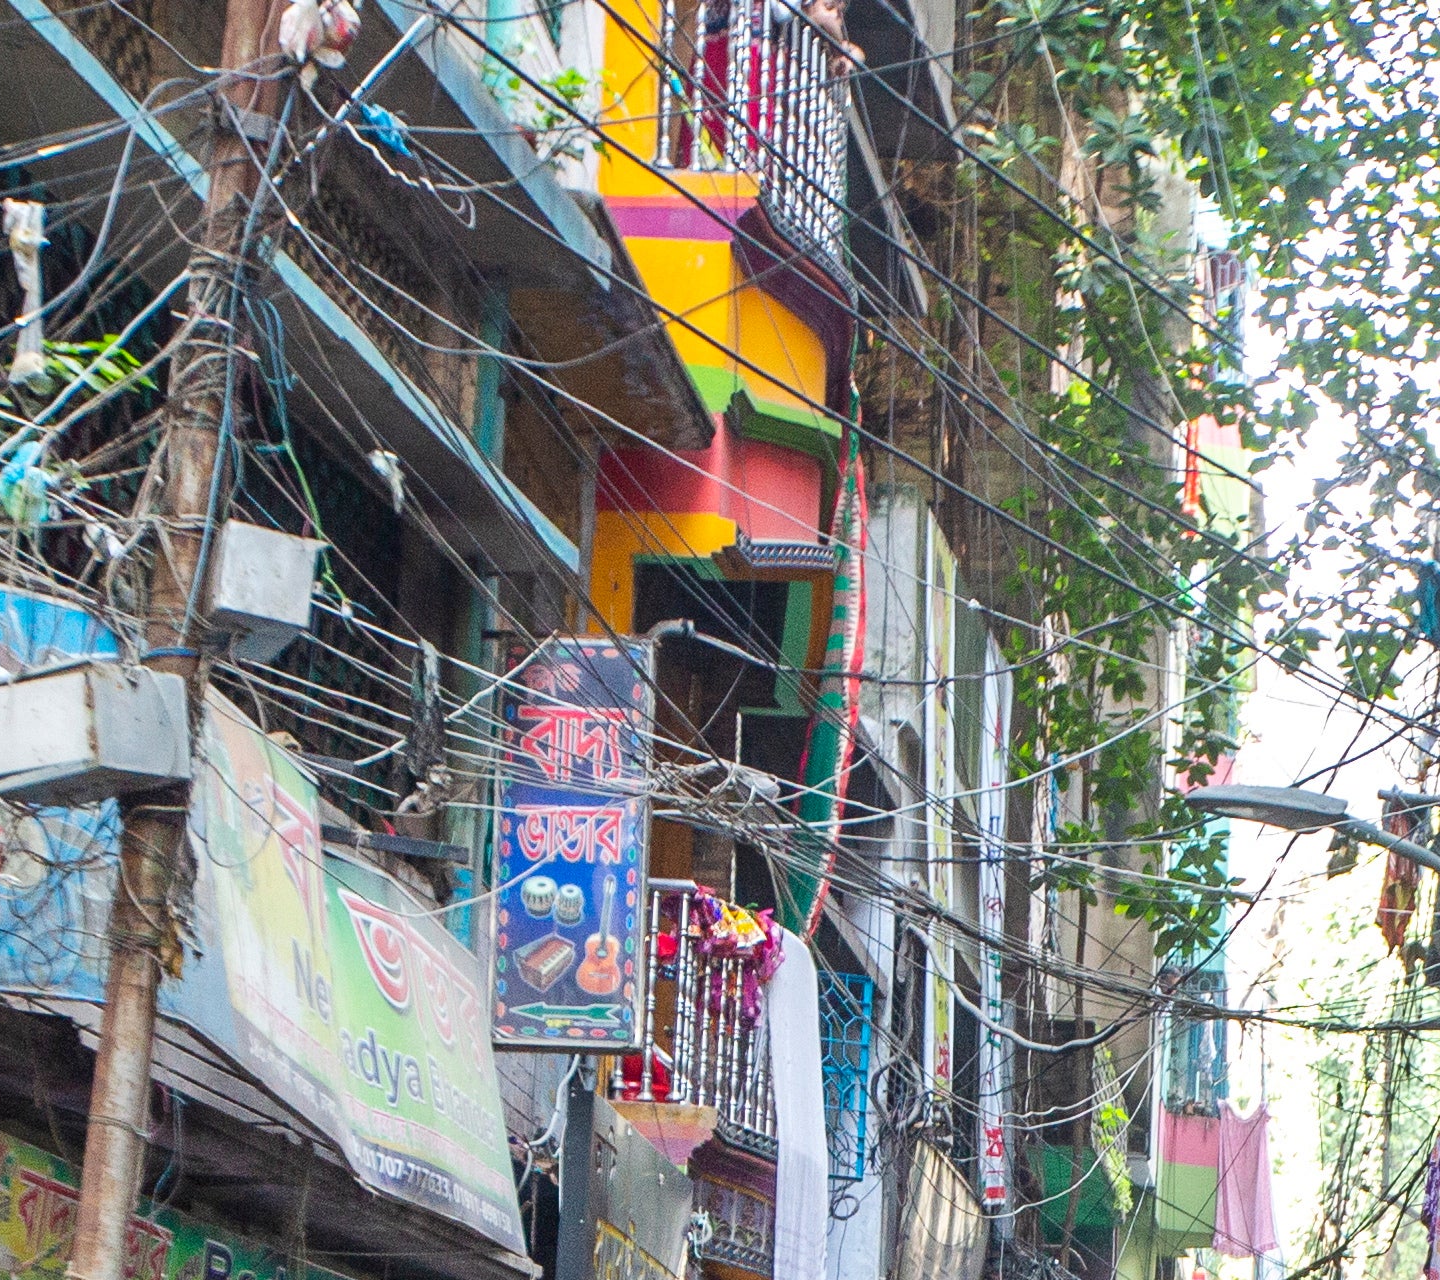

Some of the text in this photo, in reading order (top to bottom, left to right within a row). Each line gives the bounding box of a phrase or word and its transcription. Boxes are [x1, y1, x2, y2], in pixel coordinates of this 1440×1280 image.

[517, 705, 628, 784] বাদ্য
[516, 804, 625, 865] ভাণ্ডার
[291, 937, 333, 1025] Ne
[339, 1027, 423, 1108] adya
